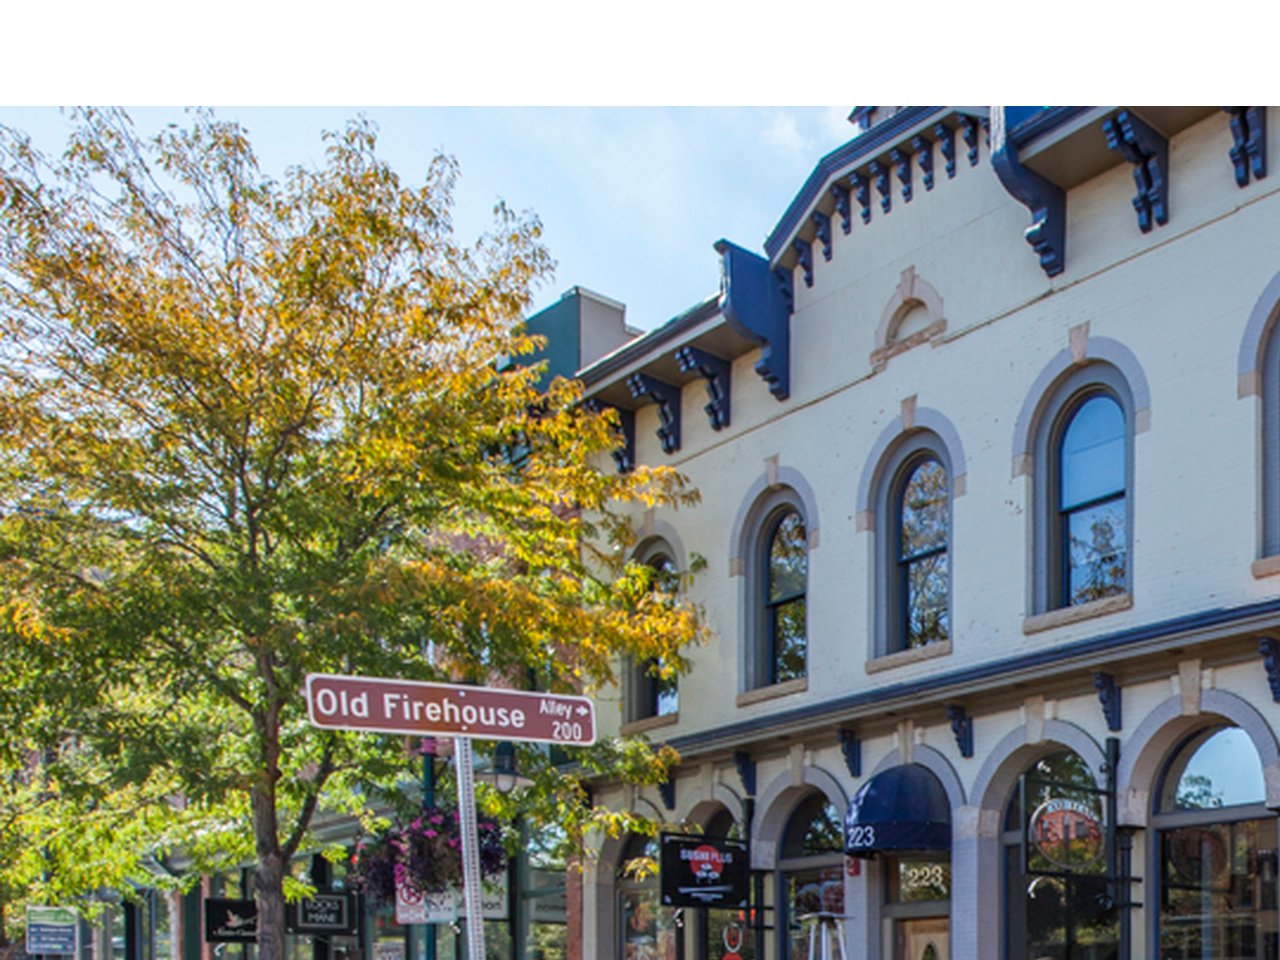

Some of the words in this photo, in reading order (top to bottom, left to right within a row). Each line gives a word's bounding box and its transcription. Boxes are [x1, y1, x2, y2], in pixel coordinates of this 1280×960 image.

[316, 688, 369, 718] Old
[383, 692, 526, 728] Firehouse
[540, 698, 572, 719] Alley
[552, 720, 582, 741] 200
[847, 825, 876, 849] 223
[680, 849, 709, 861] SUSHI
[711, 851, 733, 863] PLUS
[908, 865, 943, 887] 223
